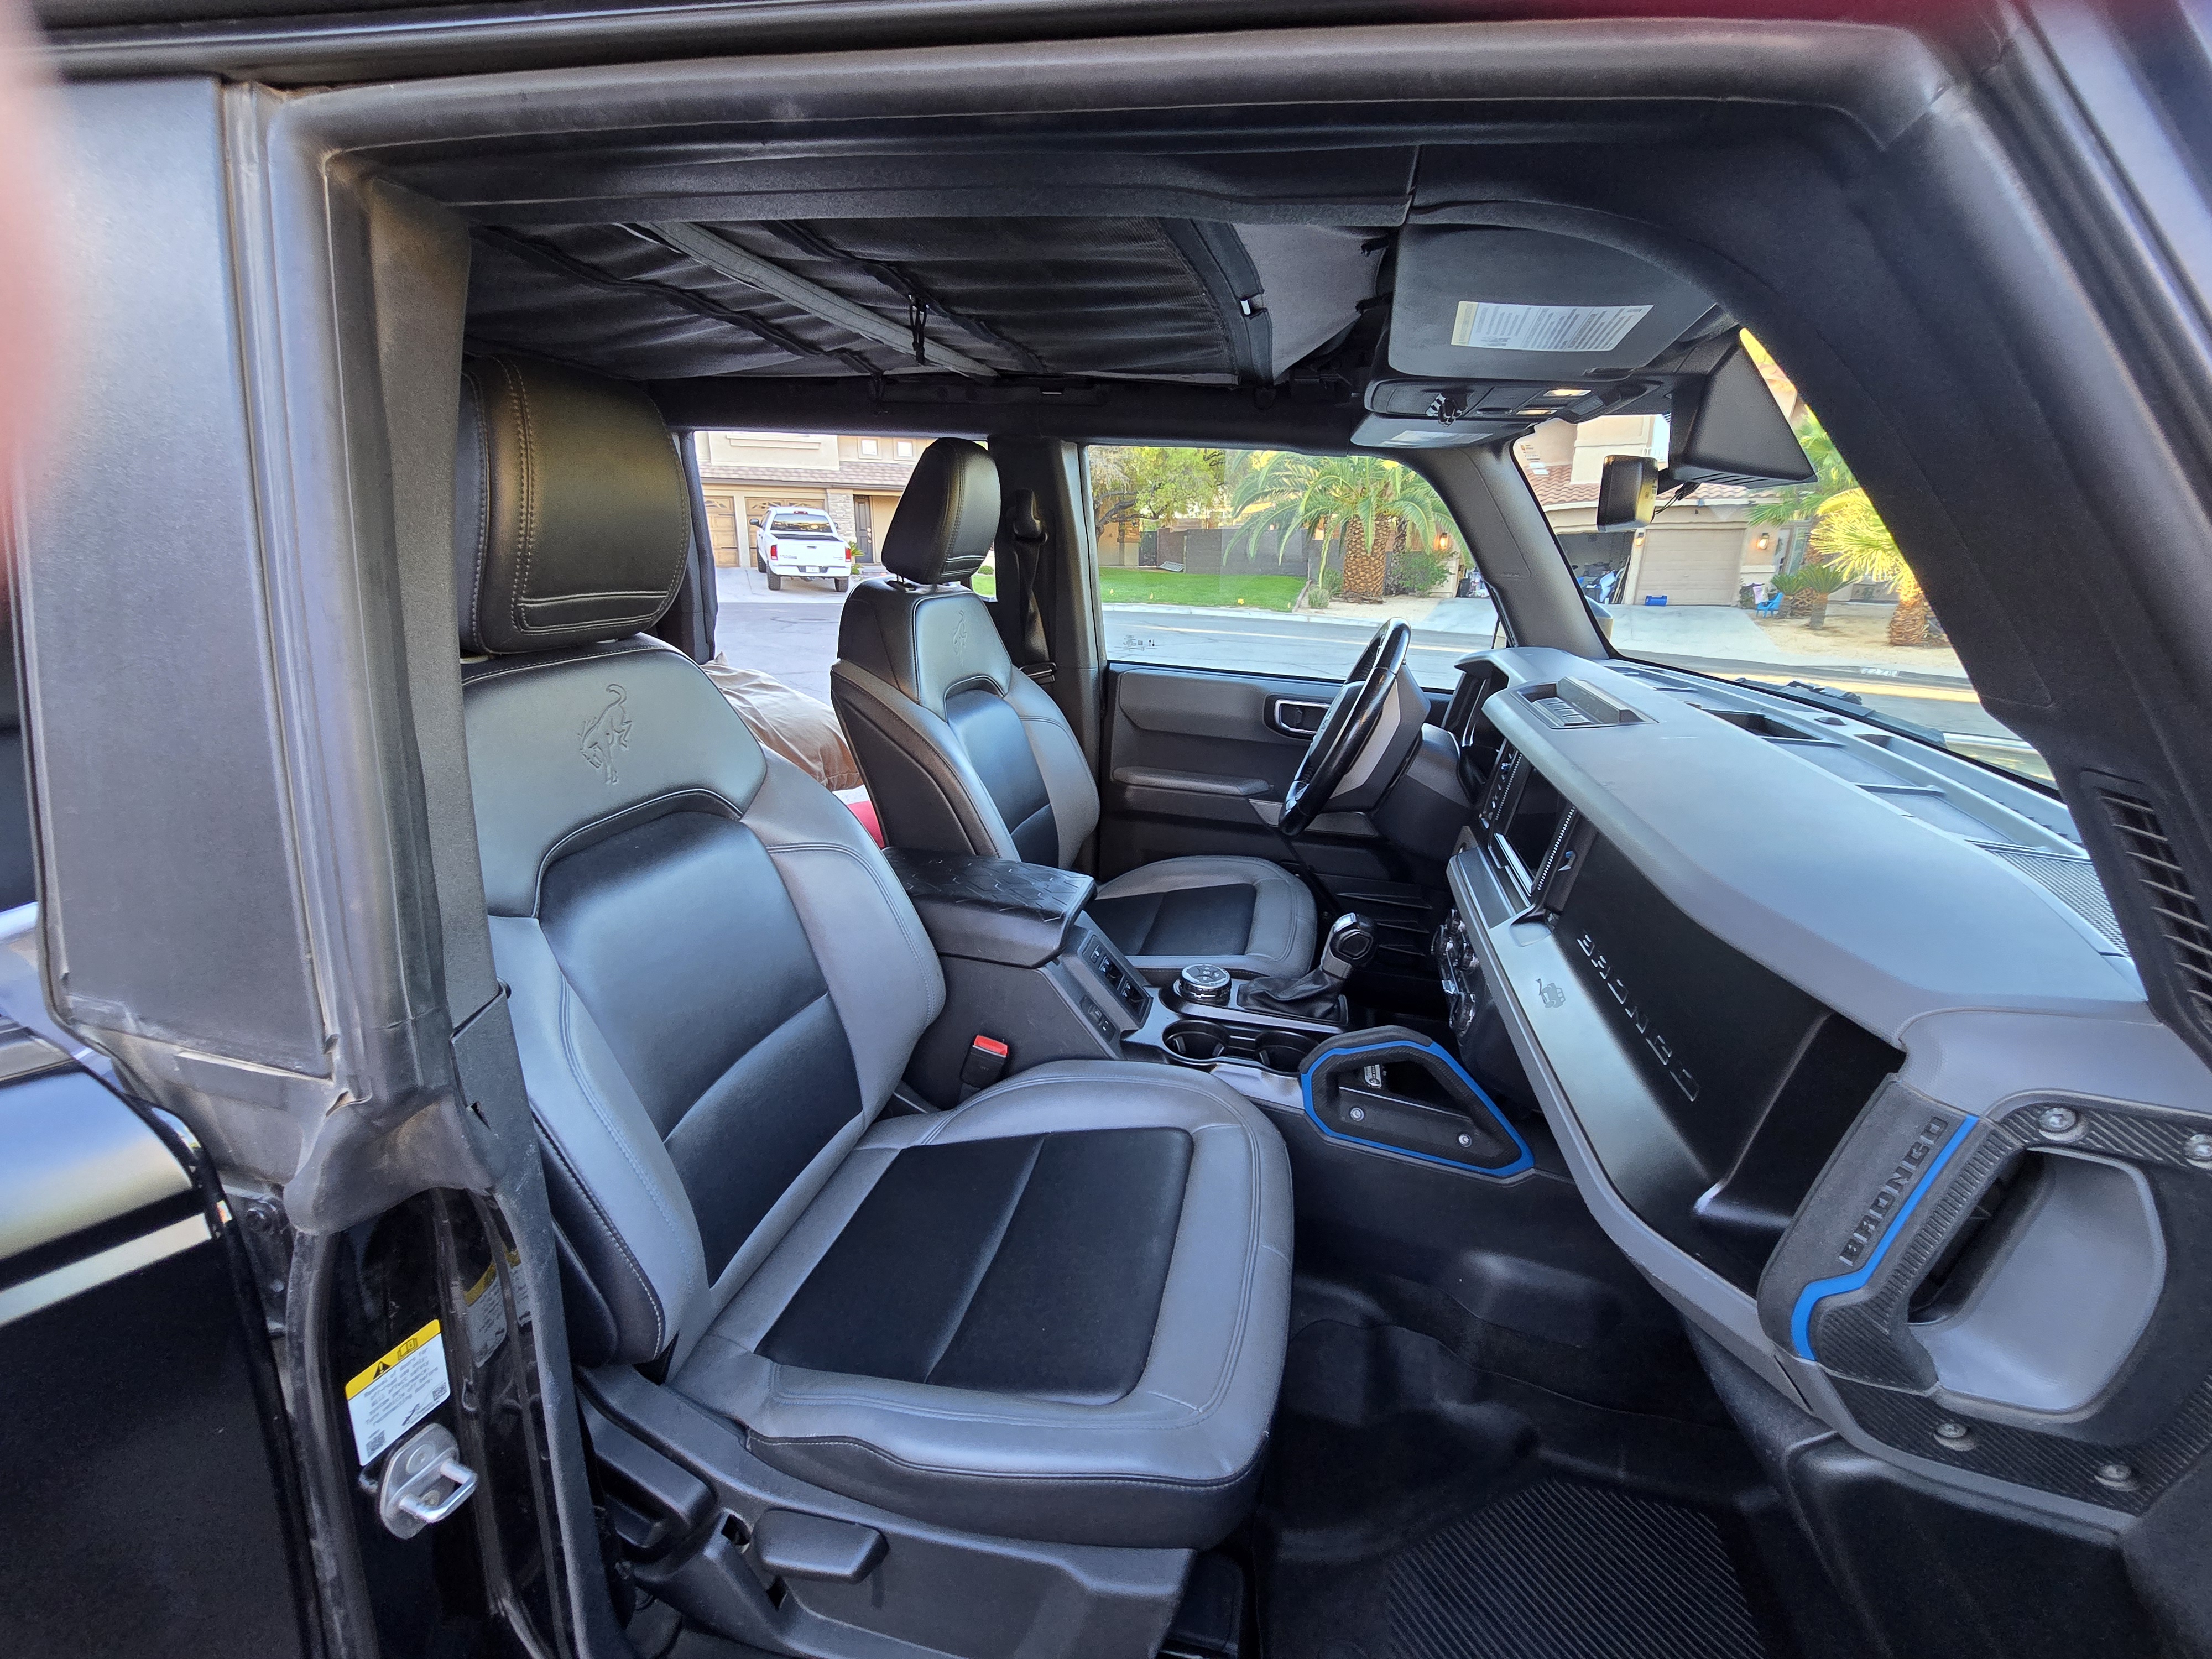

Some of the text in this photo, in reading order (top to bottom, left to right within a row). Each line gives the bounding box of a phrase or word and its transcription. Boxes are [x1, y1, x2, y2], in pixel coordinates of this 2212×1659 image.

[1577, 931, 1700, 1102] BRONCO
[1839, 1116, 1948, 1266] BRONCO
[390, 1370, 397, 1379] of
